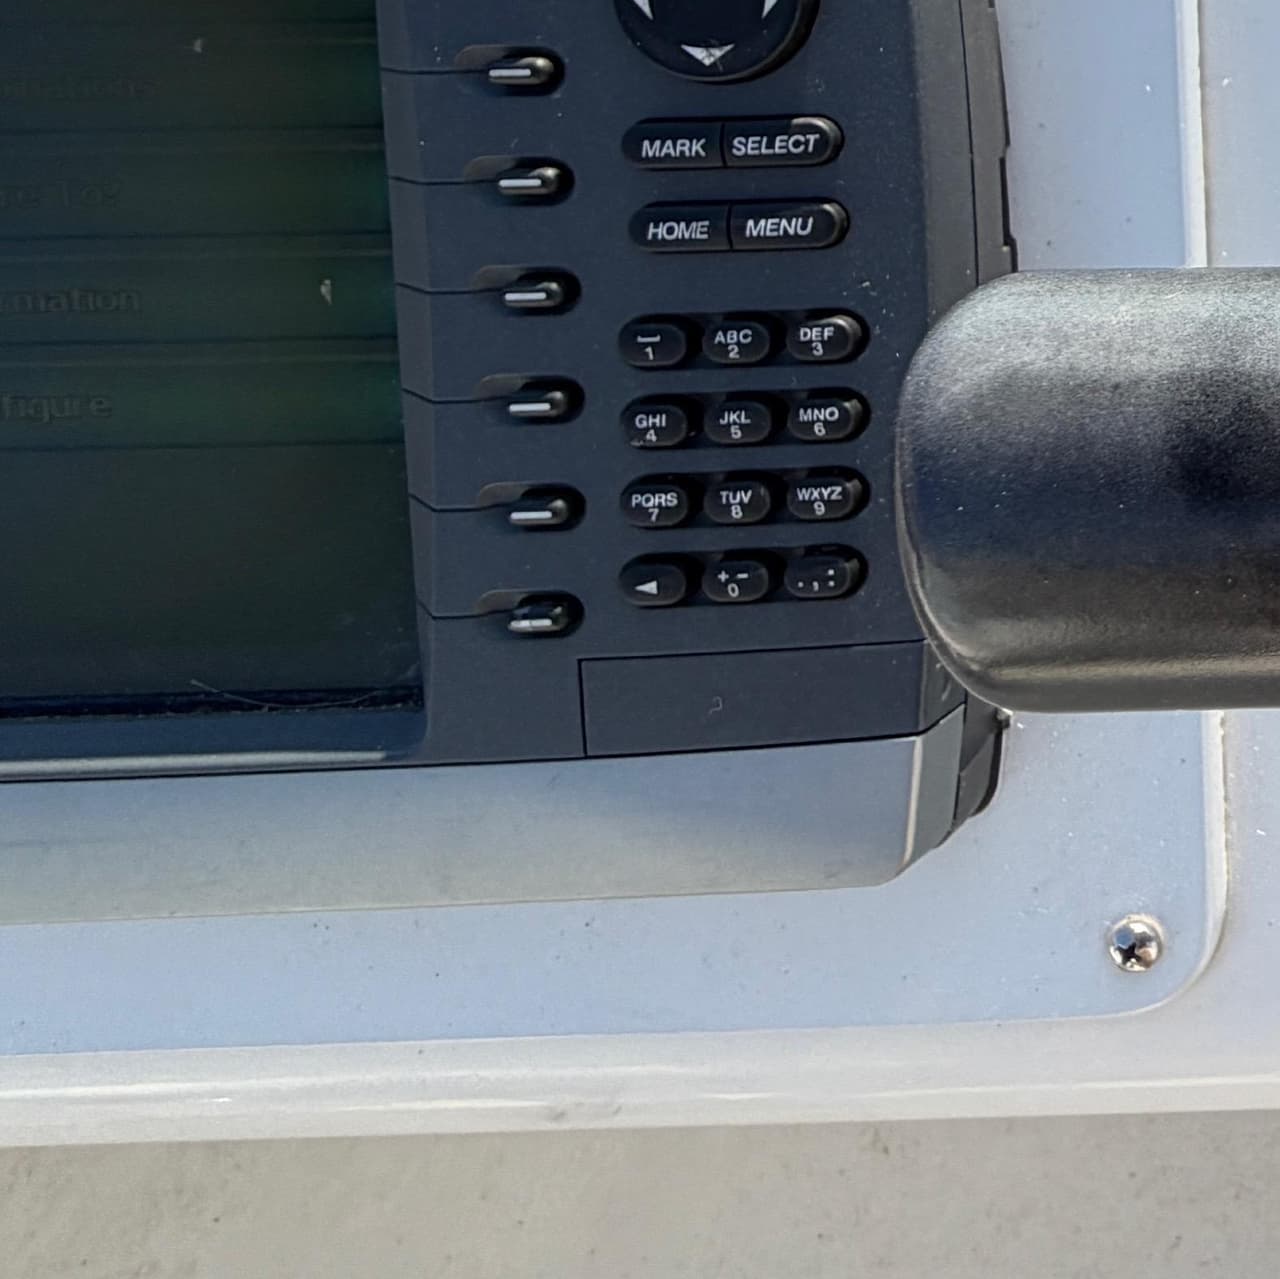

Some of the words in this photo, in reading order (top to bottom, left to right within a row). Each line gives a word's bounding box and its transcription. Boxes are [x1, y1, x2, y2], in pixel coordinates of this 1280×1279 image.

[641, 139, 706, 158] MARK
[732, 134, 820, 156] SELECT
[647, 220, 710, 241] HOME
[745, 217, 814, 238] MENU
[714, 329, 752, 344] ABC
[800, 326, 835, 341] DEF
[645, 347, 654, 360] 1
[728, 345, 740, 359] 2
[812, 341, 823, 356] 3
[635, 414, 667, 428] GHI
[719, 410, 751, 425] JKL
[799, 406, 840, 422] MNO
[646, 428, 658, 442] 4
[730, 425, 742, 439] 5
[813, 422, 826, 437] 6
[631, 493, 678, 507] PQRS
[720, 489, 752, 504] TUV
[797, 486, 842, 501] WXYZ
[649, 508, 660, 522] 7
[731, 504, 743, 519] 8
[814, 501, 826, 516] 9
[728, 584, 739, 597] 0
